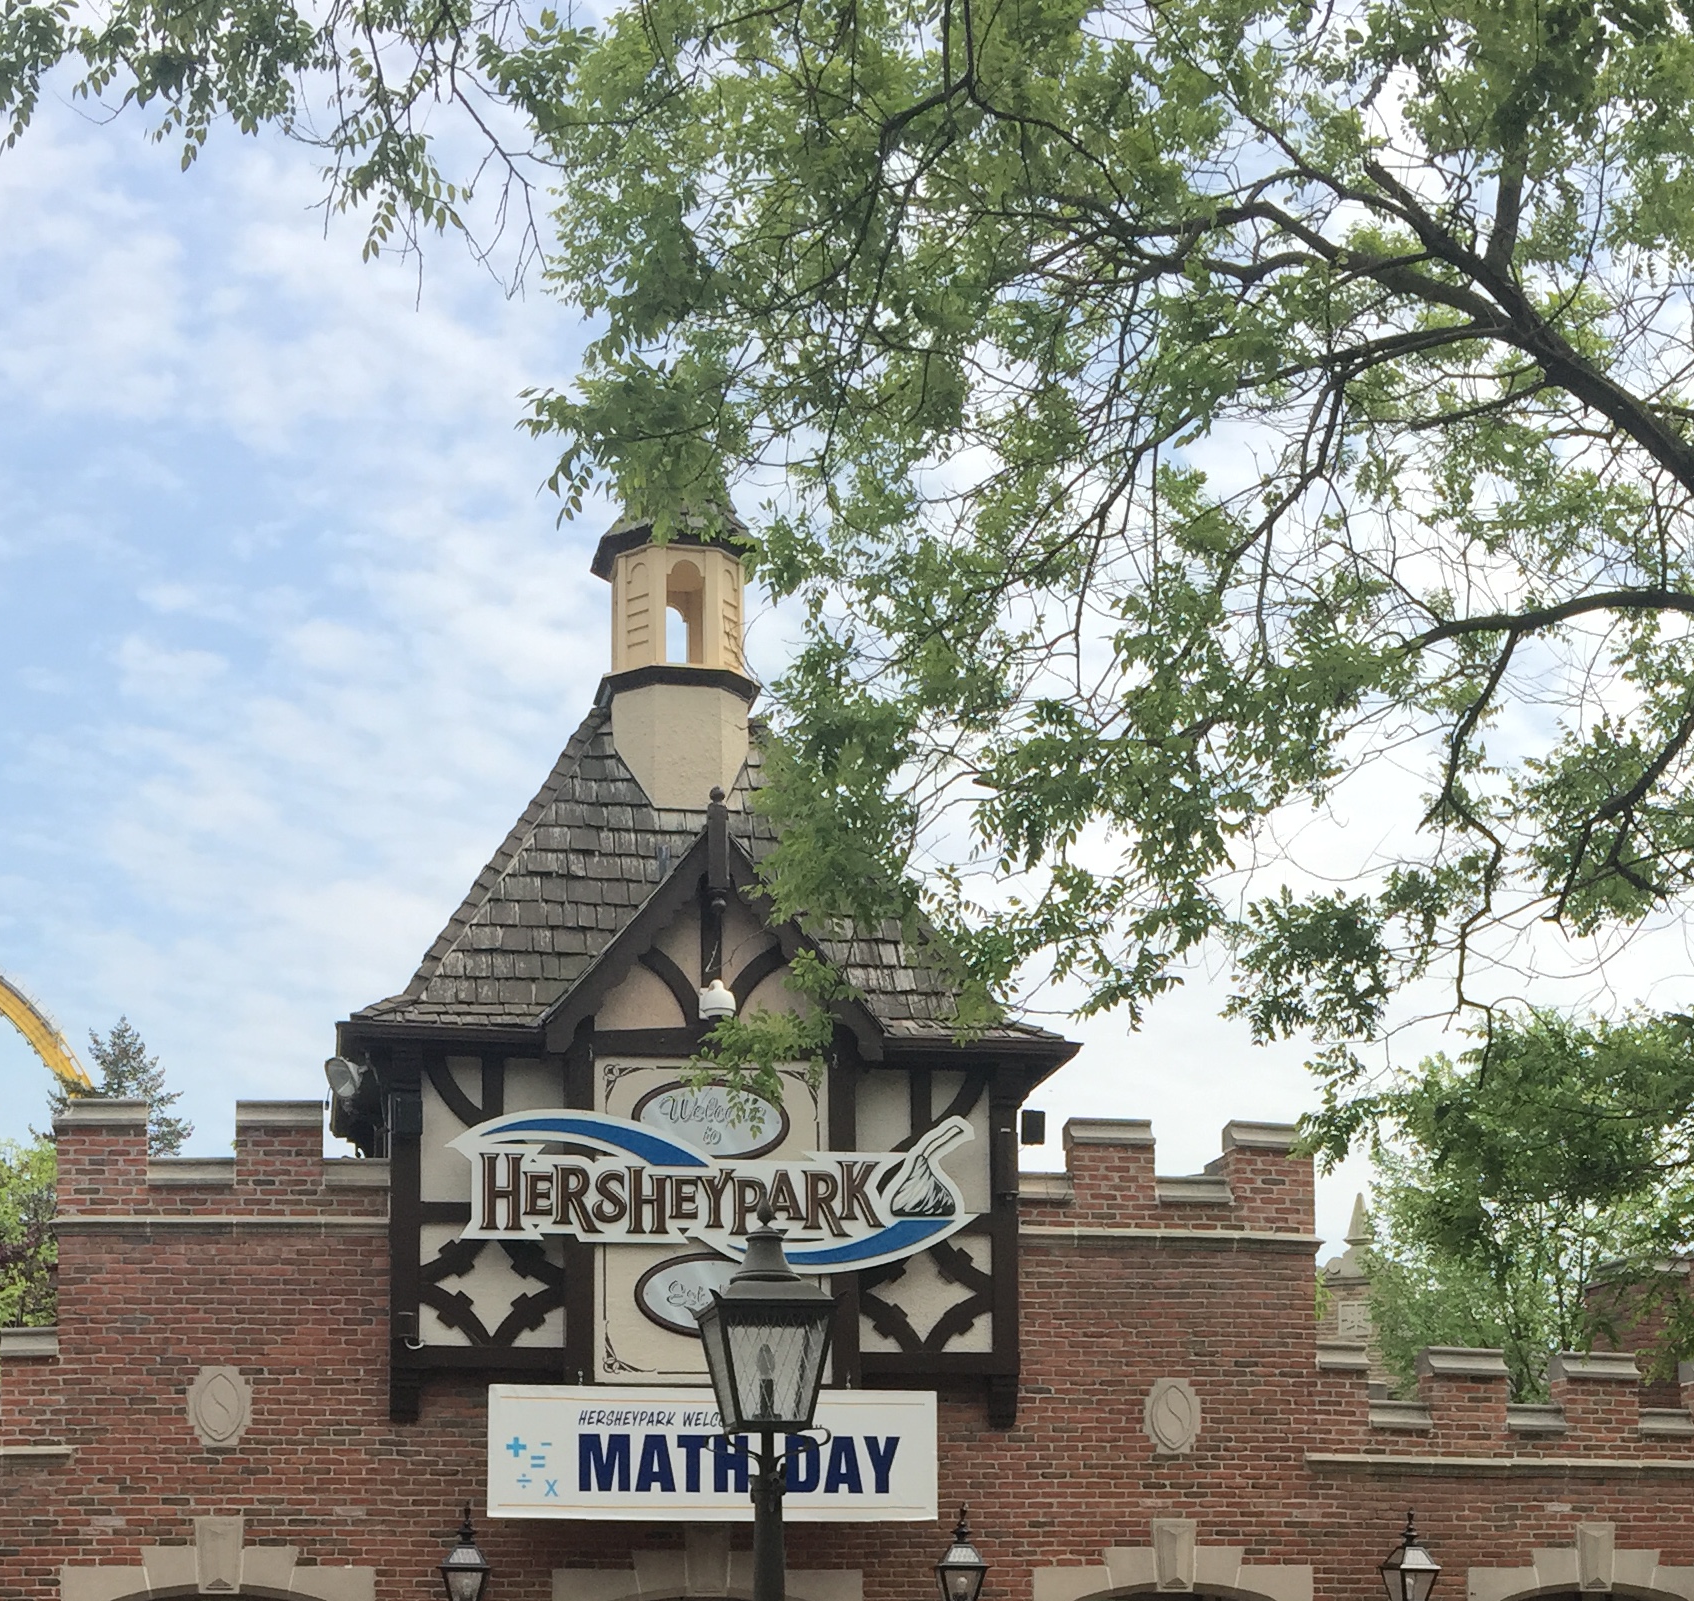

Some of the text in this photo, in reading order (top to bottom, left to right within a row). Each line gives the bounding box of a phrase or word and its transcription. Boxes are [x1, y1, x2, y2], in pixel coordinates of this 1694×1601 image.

[479, 1152, 884, 1238] HERSHEYPARK
[578, 1410, 675, 1427] HERSHEYPARK
[578, 1433, 900, 1495] MATH DAY
